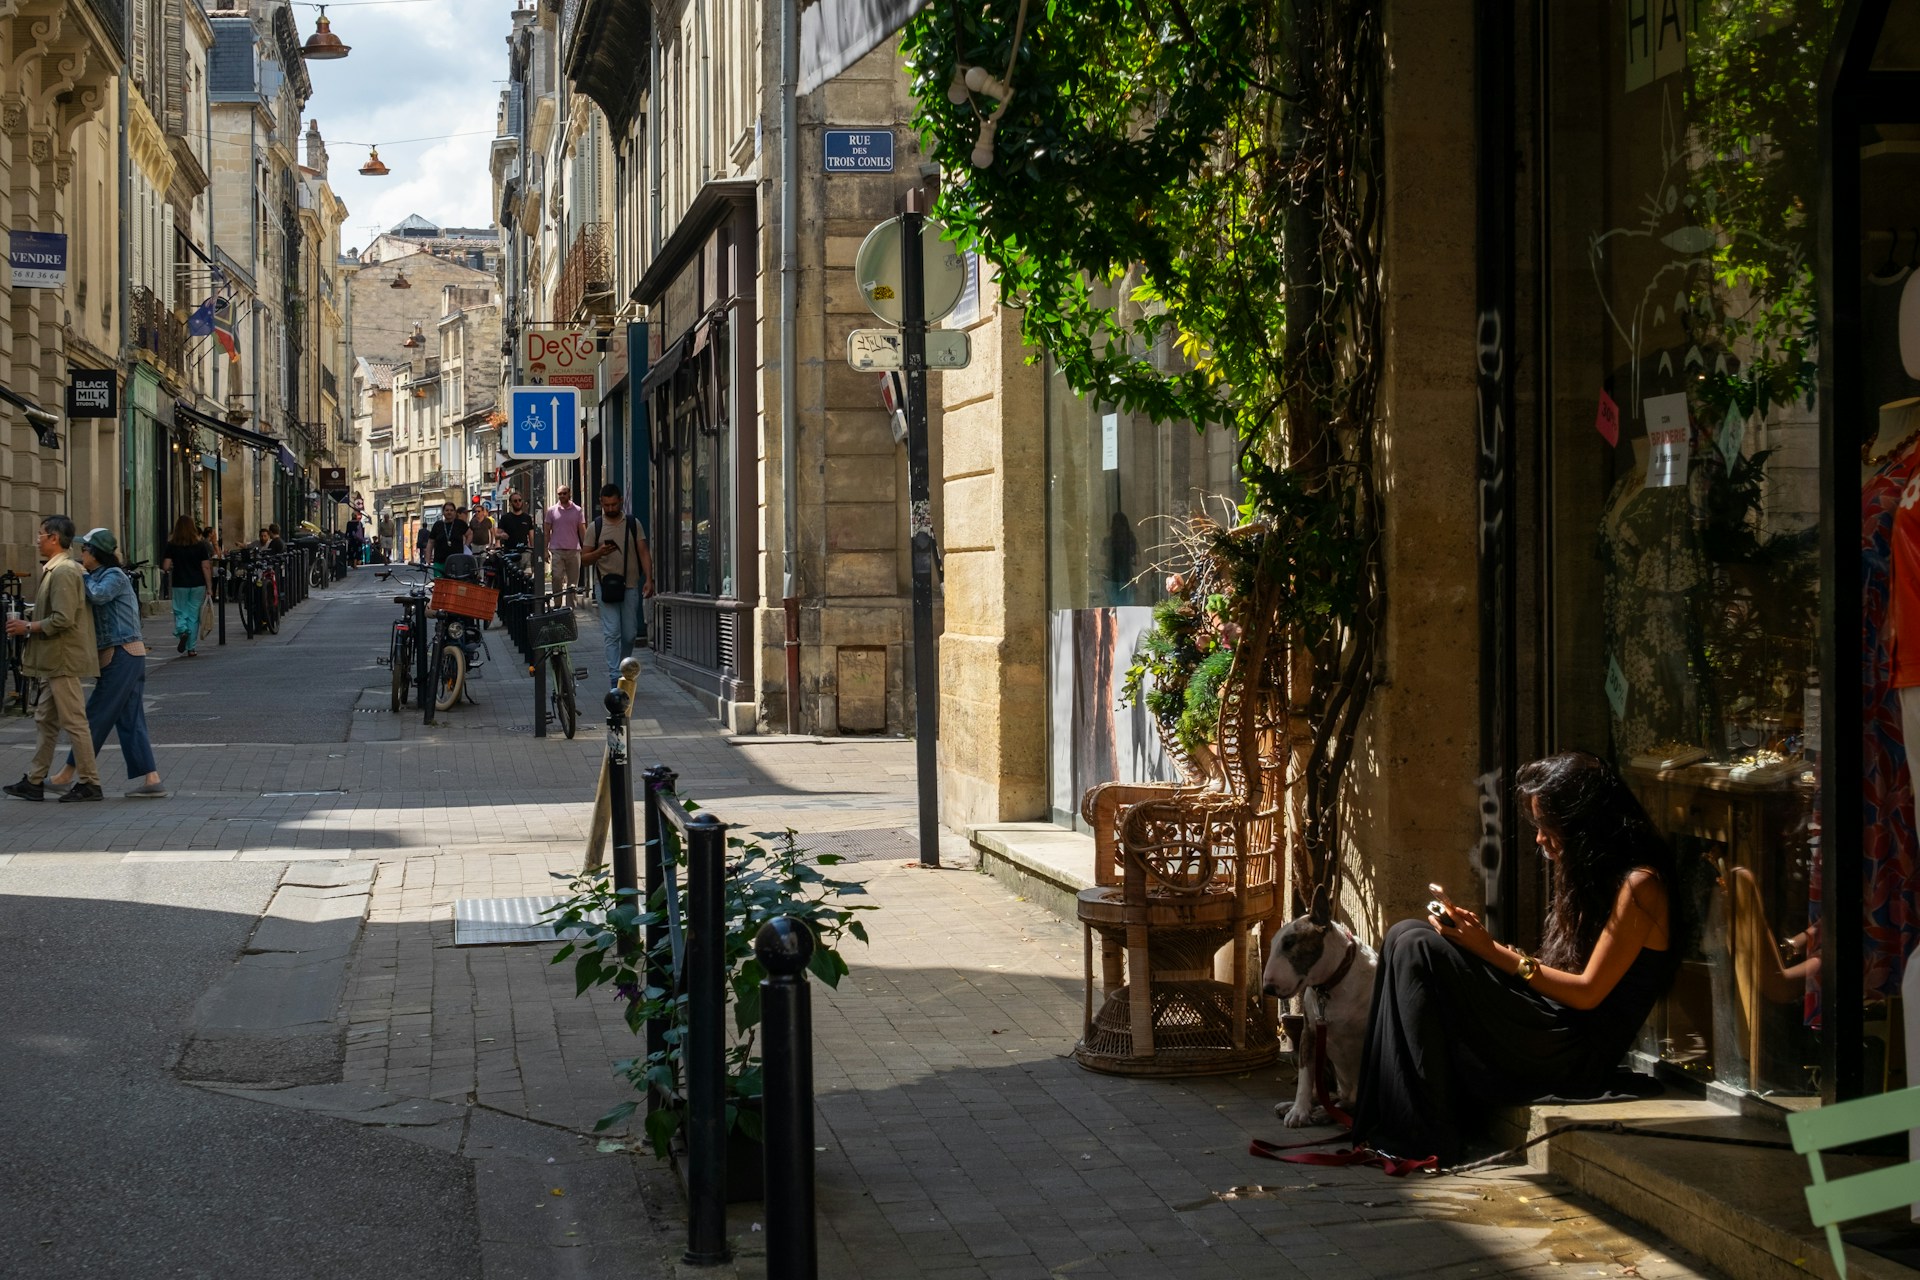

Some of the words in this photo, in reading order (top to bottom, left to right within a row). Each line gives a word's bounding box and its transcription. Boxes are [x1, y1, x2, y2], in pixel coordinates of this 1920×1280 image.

[849, 135, 871, 145] RUE
[828, 157, 855, 167] TROIS
[858, 157, 891, 167] CONILS
[11, 252, 62, 265] VENDRE
[75, 381, 109, 389] BLACK
[78, 391, 106, 400] MILK
[1601, 401, 1617, 431] 30%
[1650, 427, 1686, 446] BRADERIE
[1609, 667, 1625, 705] 30%
